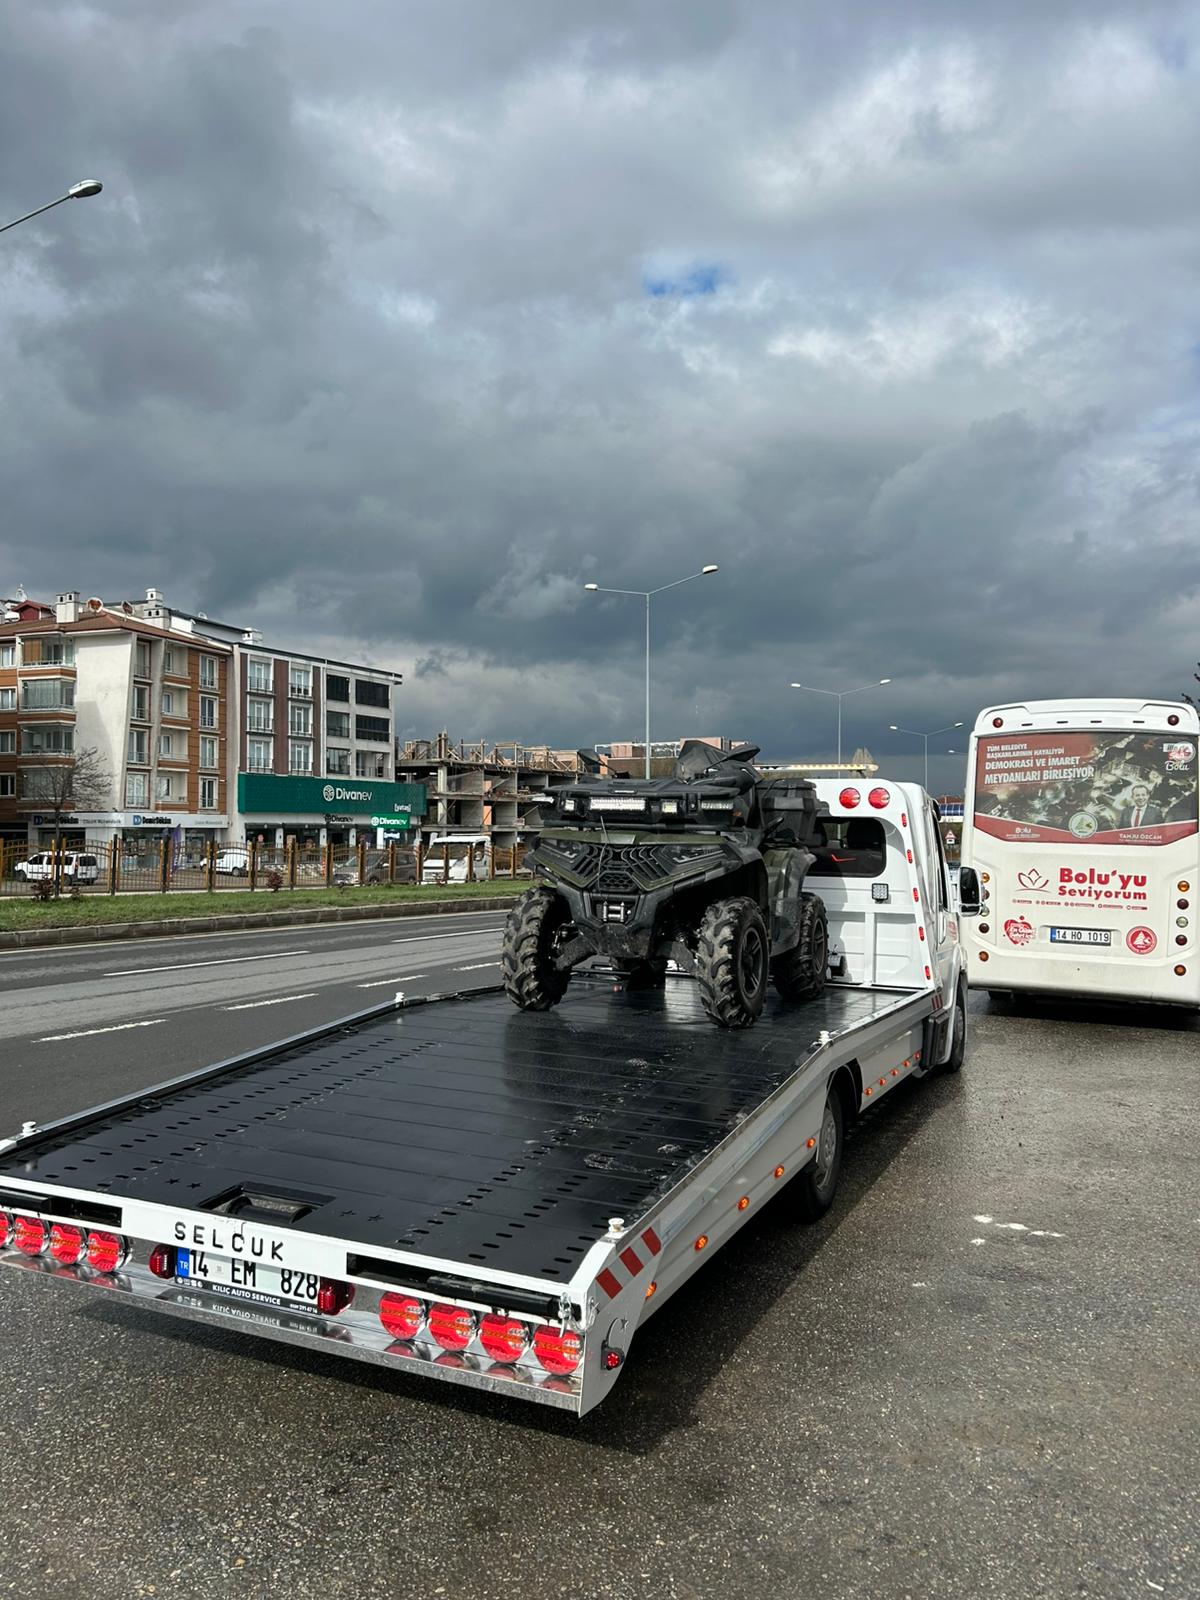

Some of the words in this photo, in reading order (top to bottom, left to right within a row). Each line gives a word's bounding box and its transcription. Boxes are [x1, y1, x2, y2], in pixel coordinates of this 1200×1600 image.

[986, 744, 1000, 752] TÜM
[985, 757, 1034, 770] DEMOKRASİ
[1035, 758, 1046, 767] VE
[1048, 756, 1080, 766] İMARET
[1164, 759, 1190, 771] Bolu
[984, 770, 1041, 785] MEYDANLARI
[1042, 764, 1095, 781] BİRLEŞİYOR
[335, 787, 373, 801] Divanev
[379, 817, 408, 826] Divanev
[1059, 867, 1147, 890] Bolu'yu
[1058, 885, 1147, 900] Seviyorum
[1056, 930, 1067, 939] 14
[1088, 932, 1109, 942] 1019
[174, 1221, 284, 1262] SELCUK
[180, 1260, 189, 1269] TR
[190, 1249, 209, 1277] 14
[231, 1257, 257, 1288] EM
[280, 1268, 318, 1300] 828
[212, 1284, 231, 1295] KILIÇ
[231, 1289, 251, 1299] AUTO
[252, 1293, 281, 1305] SERVICE
